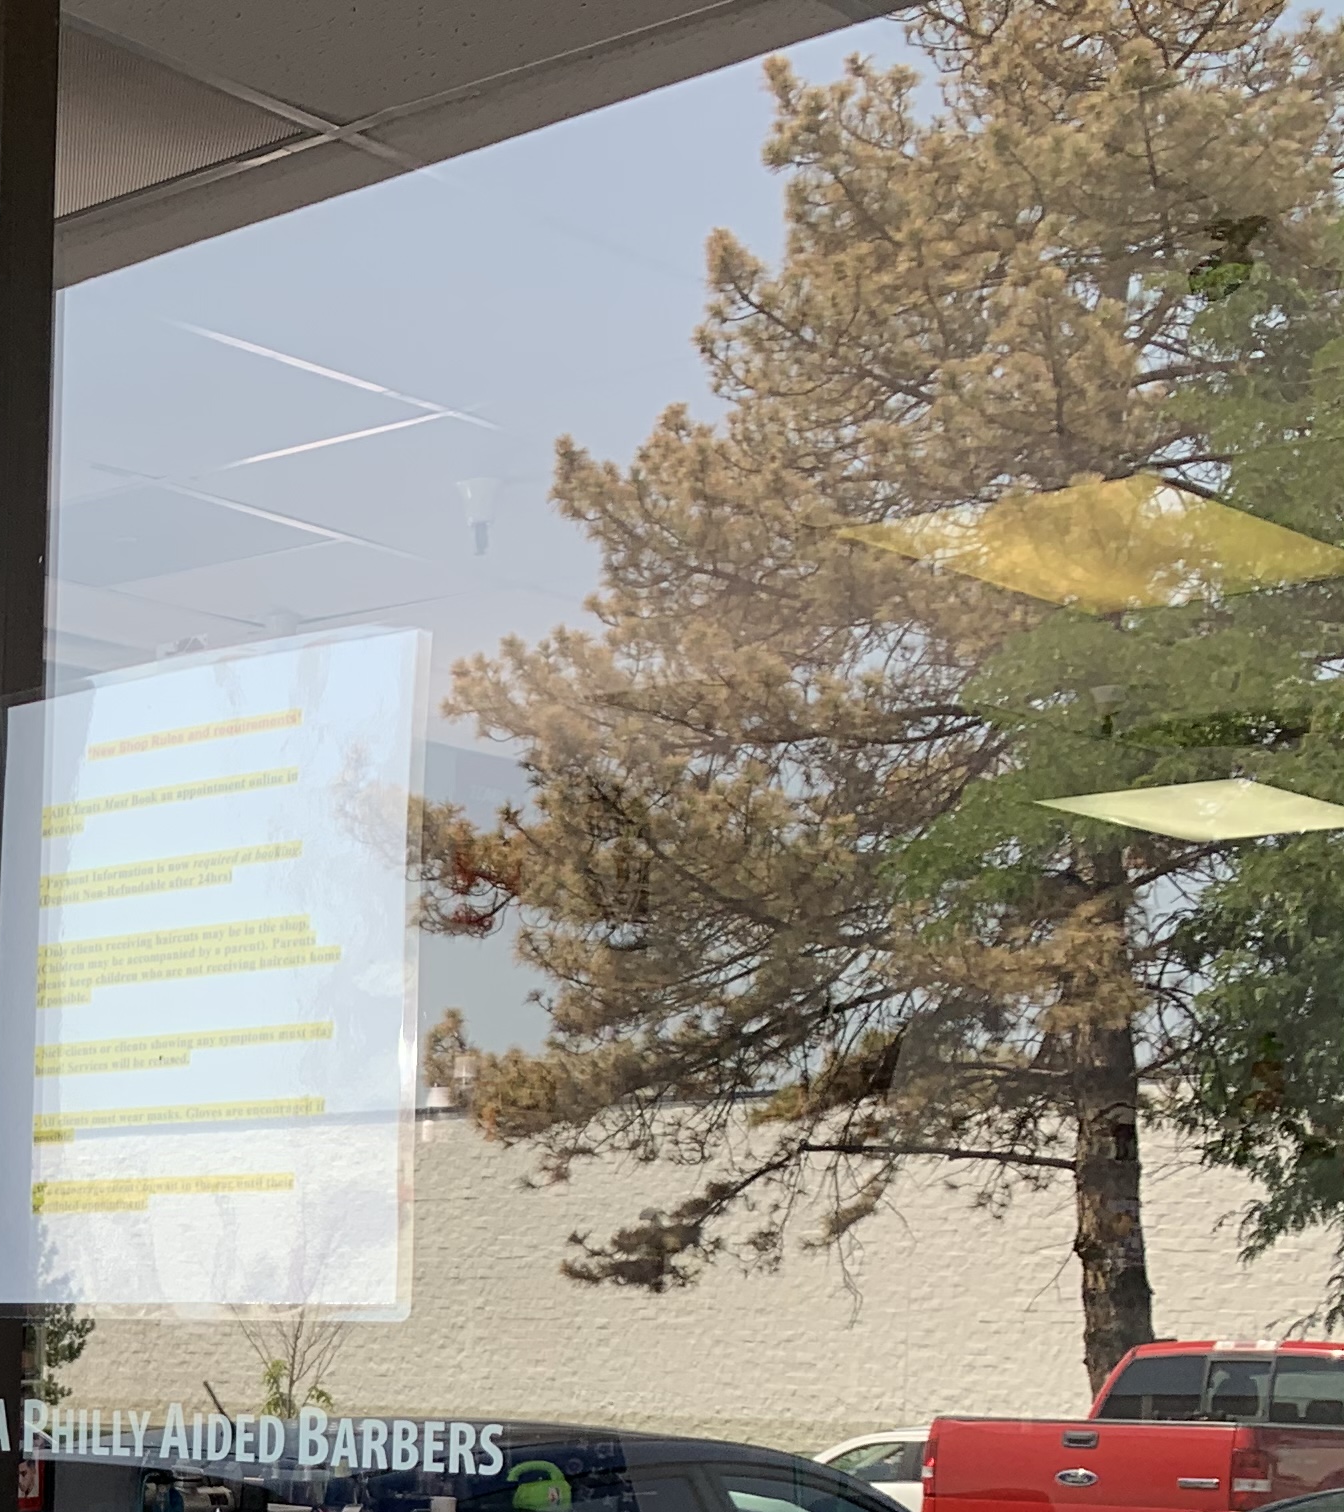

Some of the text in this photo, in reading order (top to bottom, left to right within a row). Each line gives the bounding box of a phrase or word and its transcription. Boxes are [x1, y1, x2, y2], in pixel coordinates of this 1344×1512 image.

[120, 737, 149, 755] Shop
[152, 731, 184, 747] Rules
[188, 726, 210, 741] and
[92, 865, 154, 882] Information
[157, 863, 165, 875] is
[168, 862, 190, 873] now
[193, 852, 238, 872] required
[83, 878, 166, 899] Non-Refundable
[169, 874, 194, 889] after
[71, 942, 102, 957] clients
[105, 936, 152, 954] receiving
[155, 931, 199, 947] haircuts
[202, 929, 225, 944] may
[228, 925, 241, 937] be
[244, 923, 255, 935] in
[258, 920, 275, 934] the
[88, 957, 109, 971] may
[112, 953, 124, 966] be
[127, 947, 195, 967] accompanied
[198, 945, 211, 959] by
[272, 934, 316, 949] Parents
[37, 948, 341, 994] please keep children who are not receiving haircuts home
[41, 1115, 55, 1126] All
[57, 1114, 89, 1127] clients
[92, 1113, 115, 1125] must
[119, 1112, 144, 1123] wear
[186, 1106, 223, 1120] Gloves
[226, 1108, 243, 1118] are
[246, 1102, 312, 1118] encouraged
[23, 1399, 151, 1458] PHILLY
[159, 1402, 286, 1464] AIDED
[298, 1406, 505, 1476] BARBERS
